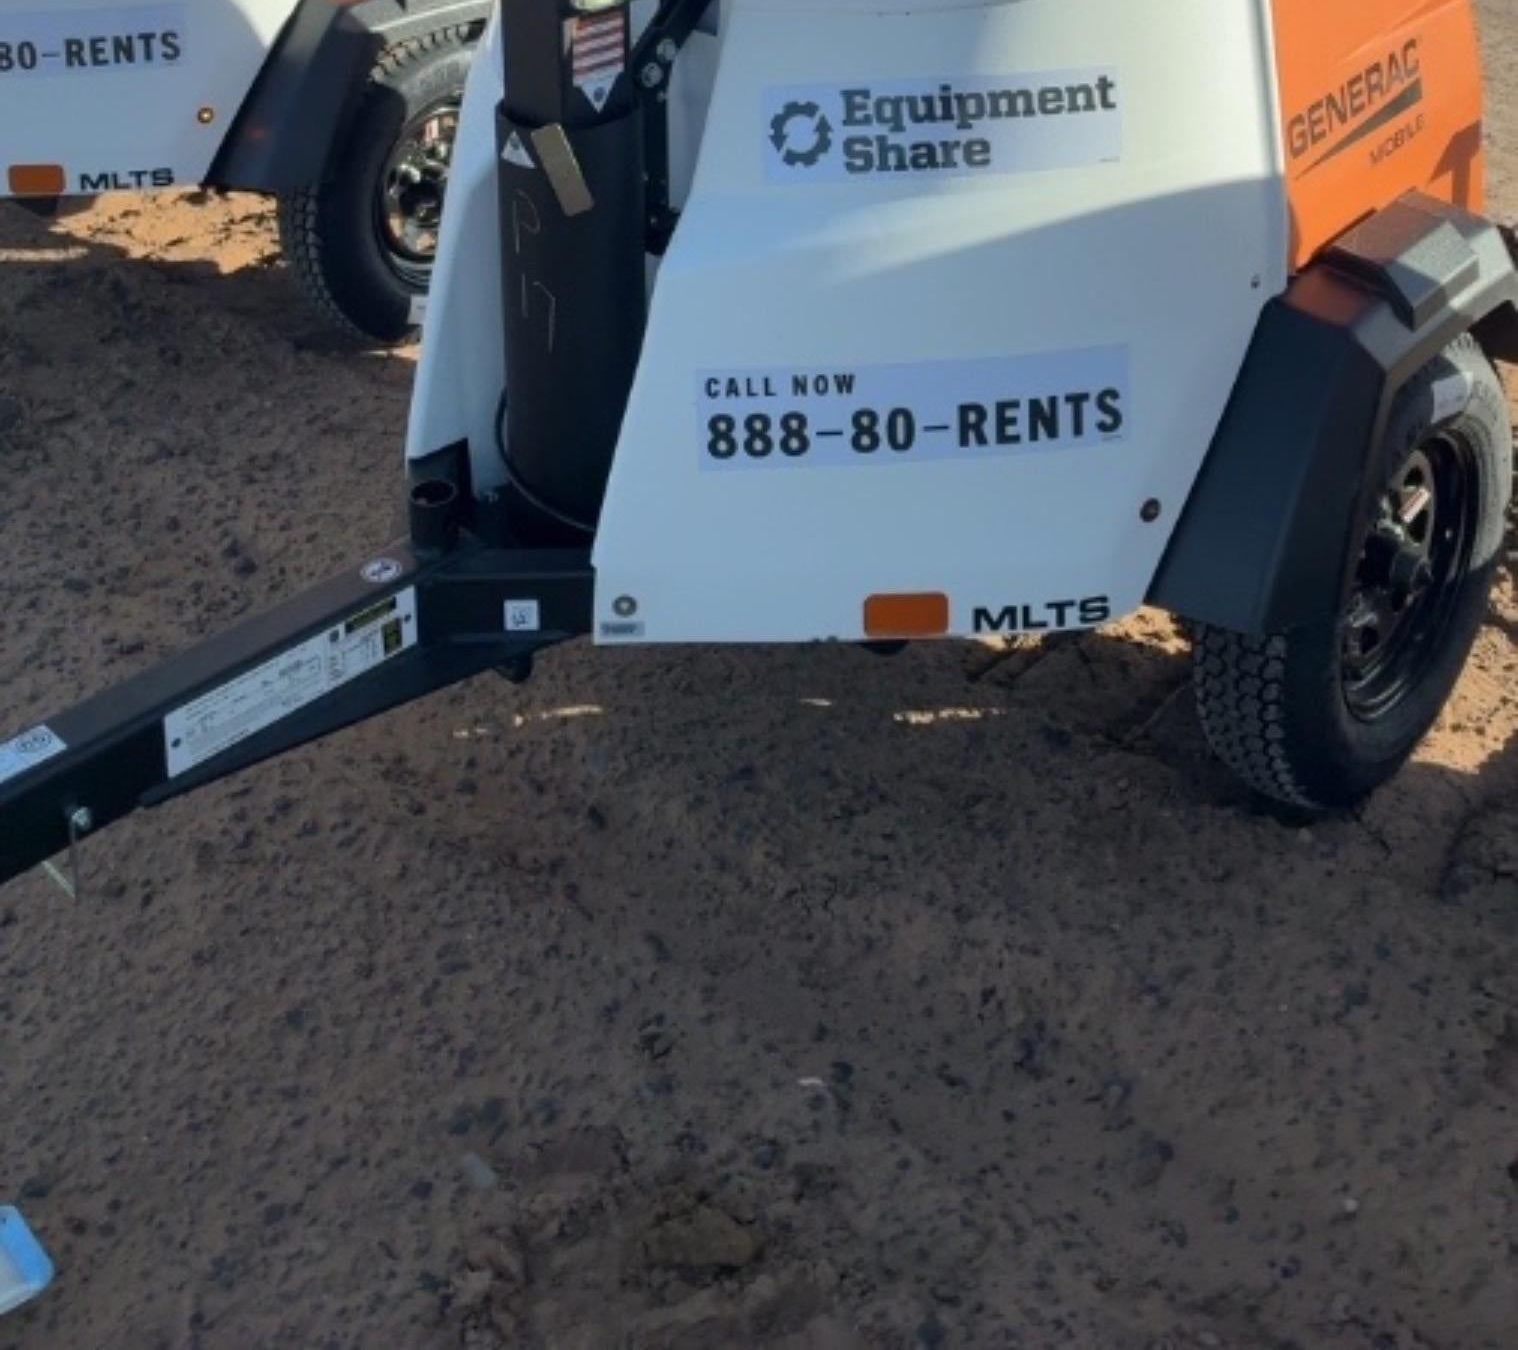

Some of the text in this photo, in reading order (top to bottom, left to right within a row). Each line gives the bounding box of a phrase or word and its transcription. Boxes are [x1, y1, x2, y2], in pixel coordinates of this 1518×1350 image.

[840, 74, 1117, 133] Equipment
[1287, 37, 1420, 160] GENERAC
[842, 134, 992, 174] Share
[79, 167, 176, 191] MLTS
[704, 373, 856, 399] CALL NOW
[706, 387, 1124, 460] 888-80-RENTS
[972, 595, 1112, 634] MLTS
